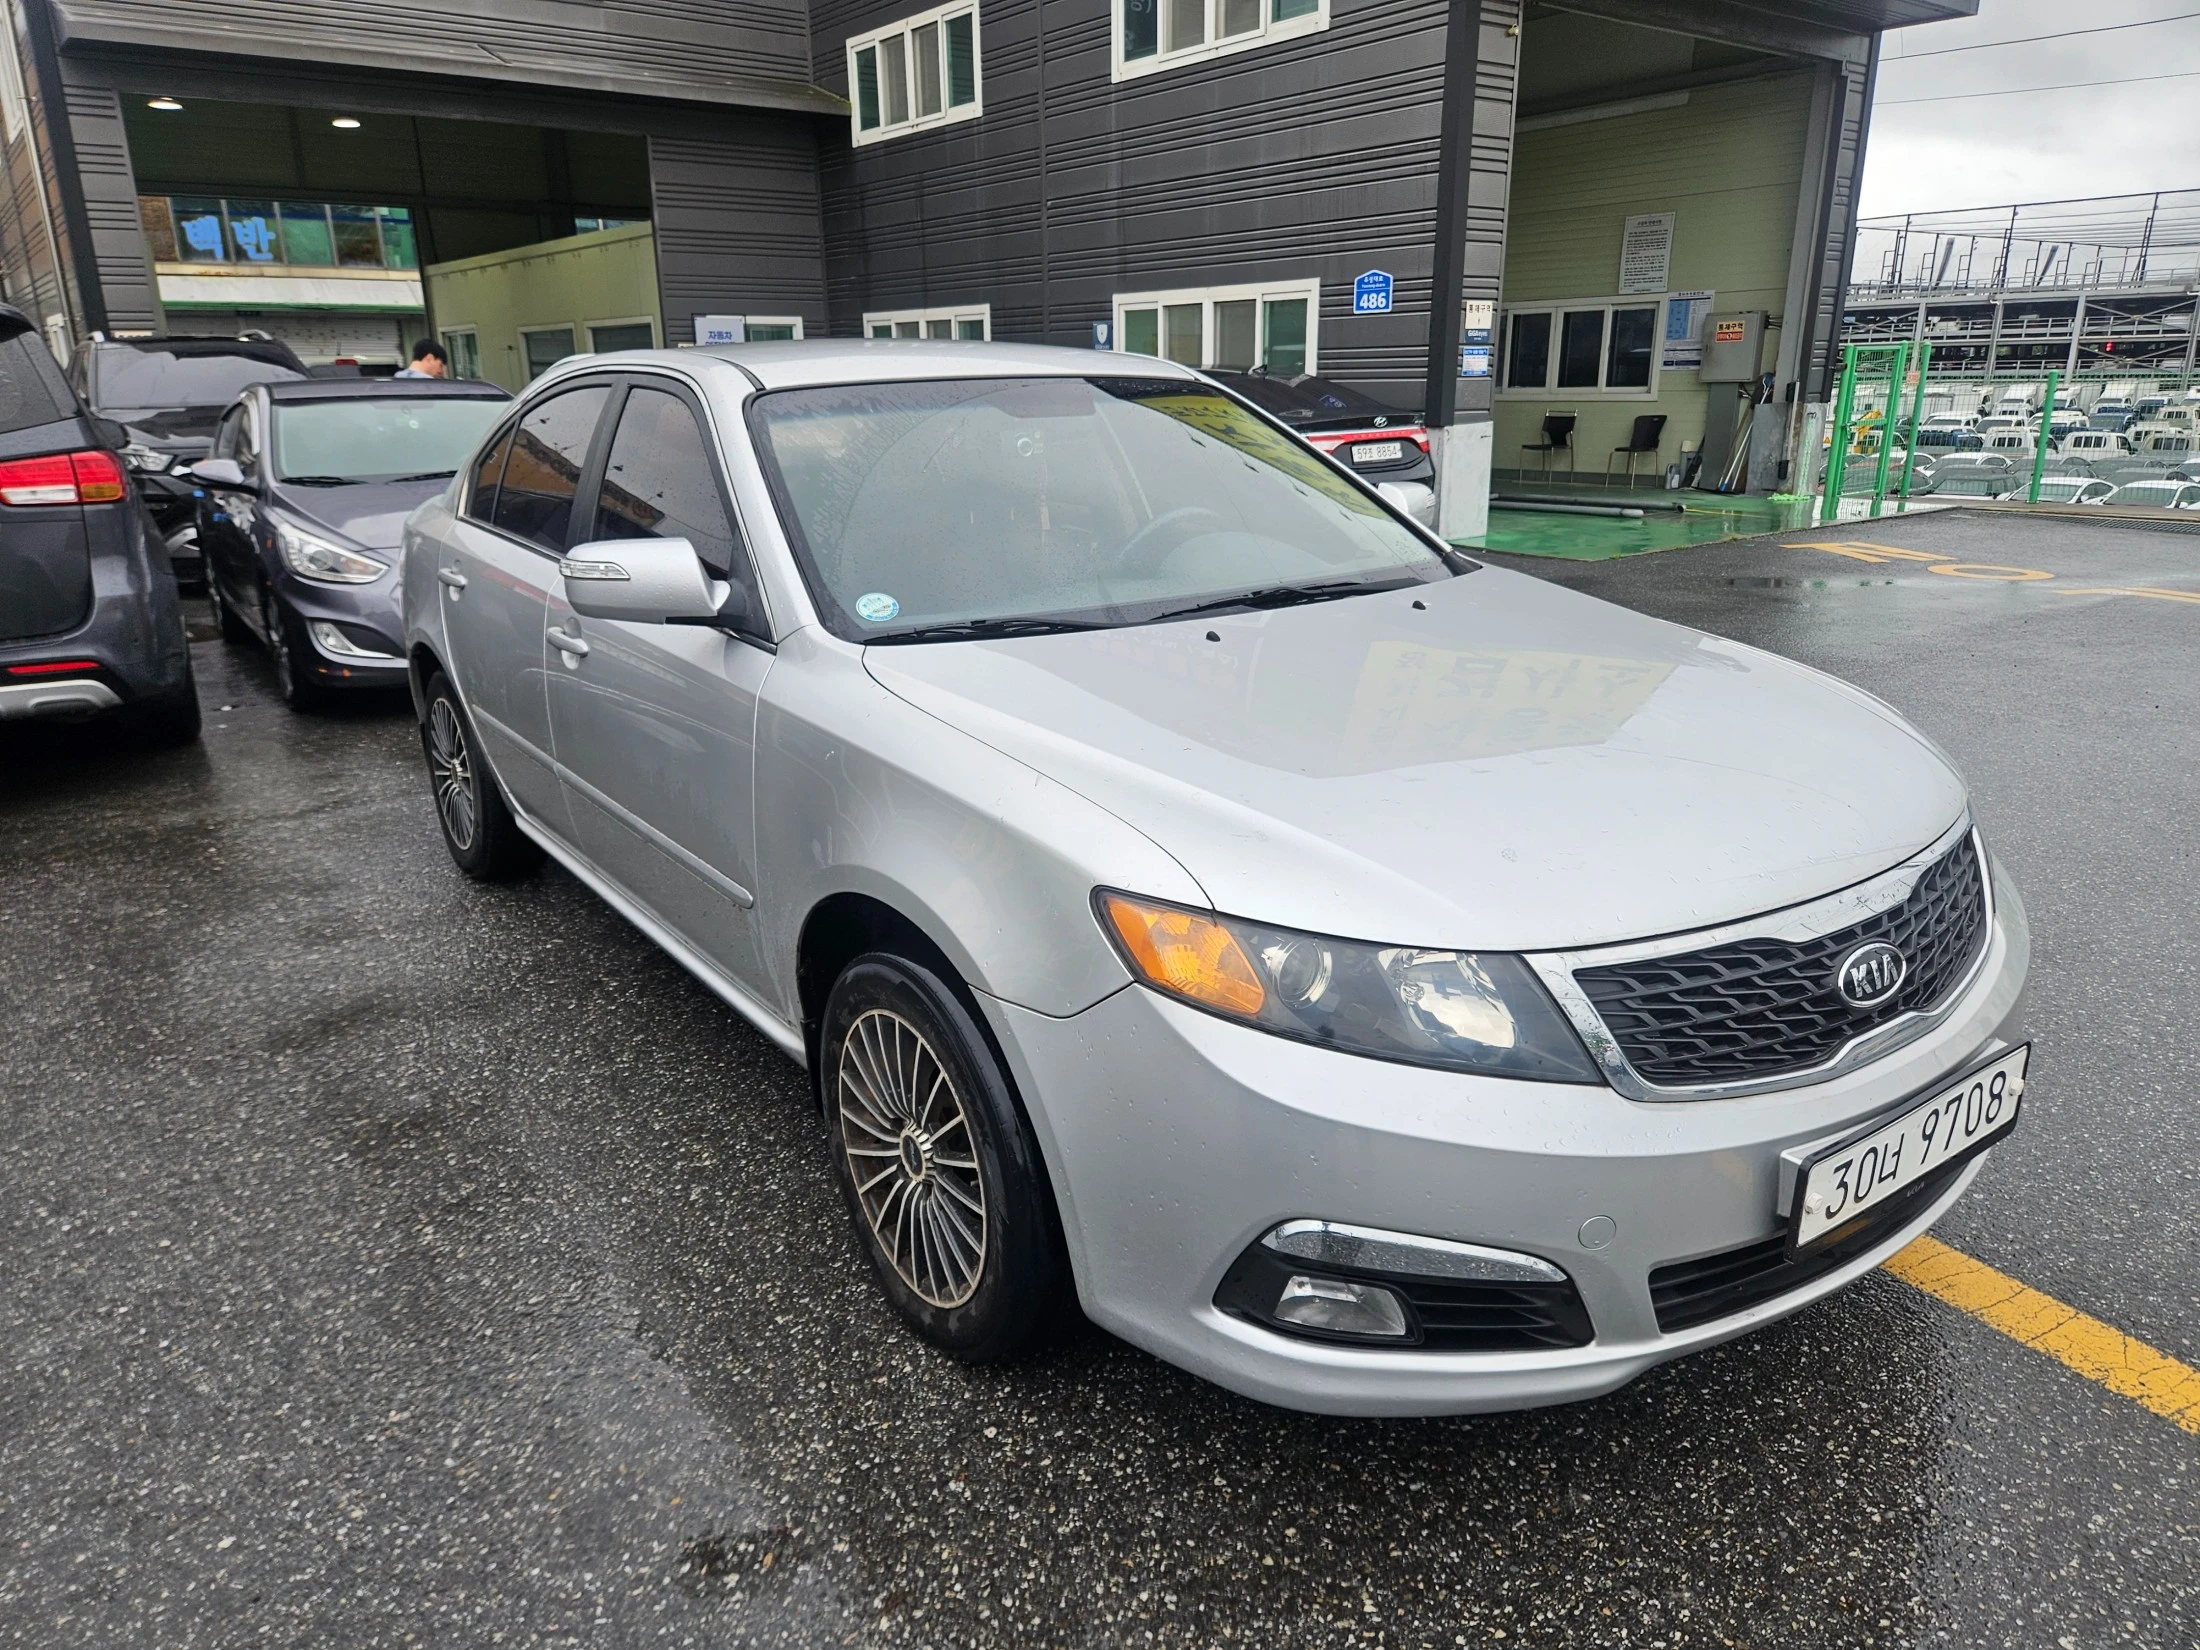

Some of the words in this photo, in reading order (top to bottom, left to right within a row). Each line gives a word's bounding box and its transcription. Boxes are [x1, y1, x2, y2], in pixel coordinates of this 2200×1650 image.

[1359, 292, 1387, 309] 486
[708, 330, 733, 340] 자동차
[1357, 447, 1373, 460] 59조
[1376, 445, 1398, 457] 8854
[1850, 953, 1899, 998] KIA
[1825, 1132, 1905, 1219] 30너
[1920, 1070, 2007, 1165] 9708
